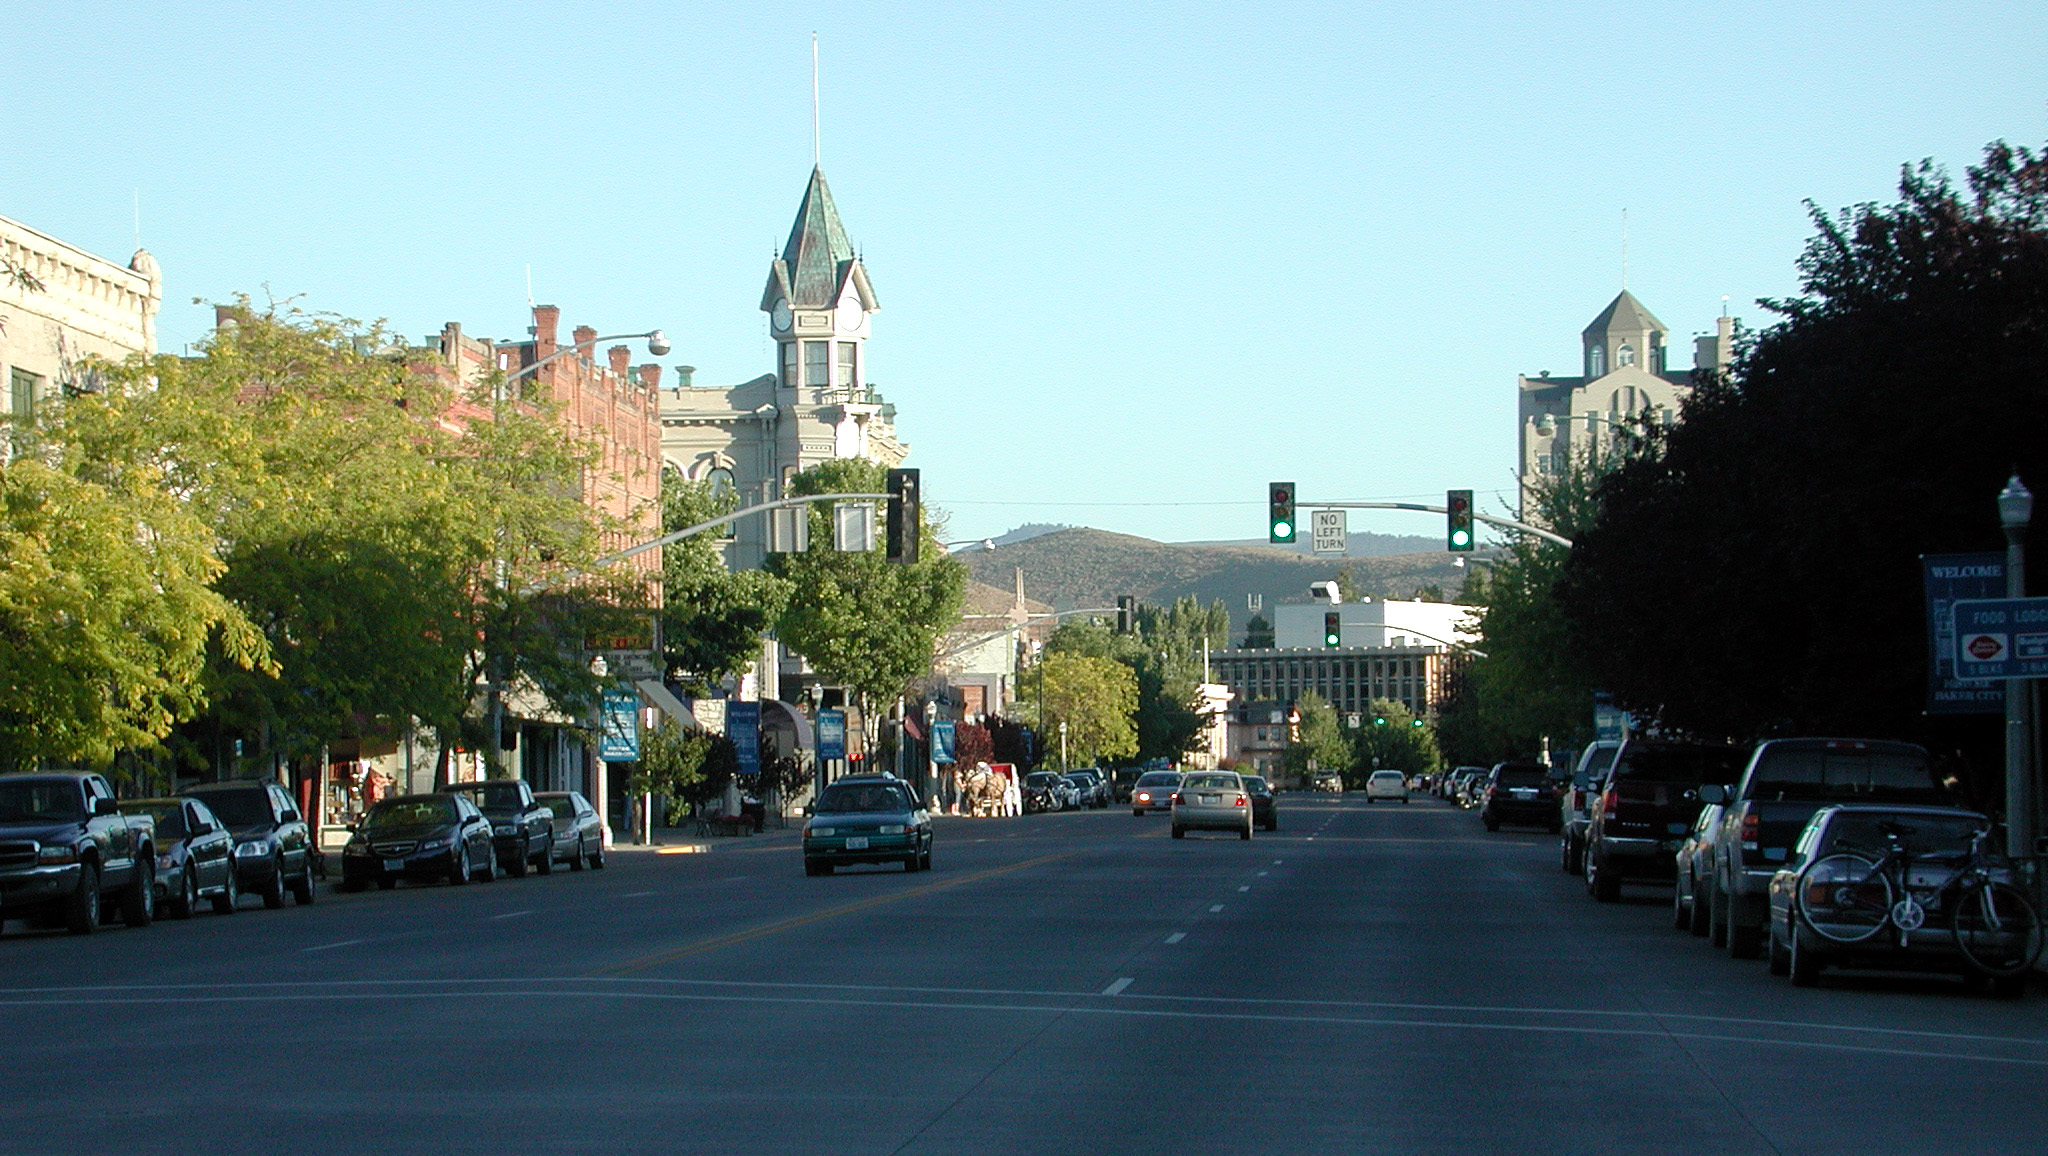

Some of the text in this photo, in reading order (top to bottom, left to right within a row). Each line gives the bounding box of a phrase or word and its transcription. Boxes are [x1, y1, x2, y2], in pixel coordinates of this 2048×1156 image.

[1320, 514, 1337, 525] NO
[1316, 527, 1342, 537] LEFT
[1316, 539, 1344, 549] TURN
[1931, 565, 2003, 577] WELCOME
[1973, 611, 2006, 624] FOOD
[1976, 690, 2003, 701] CITY
